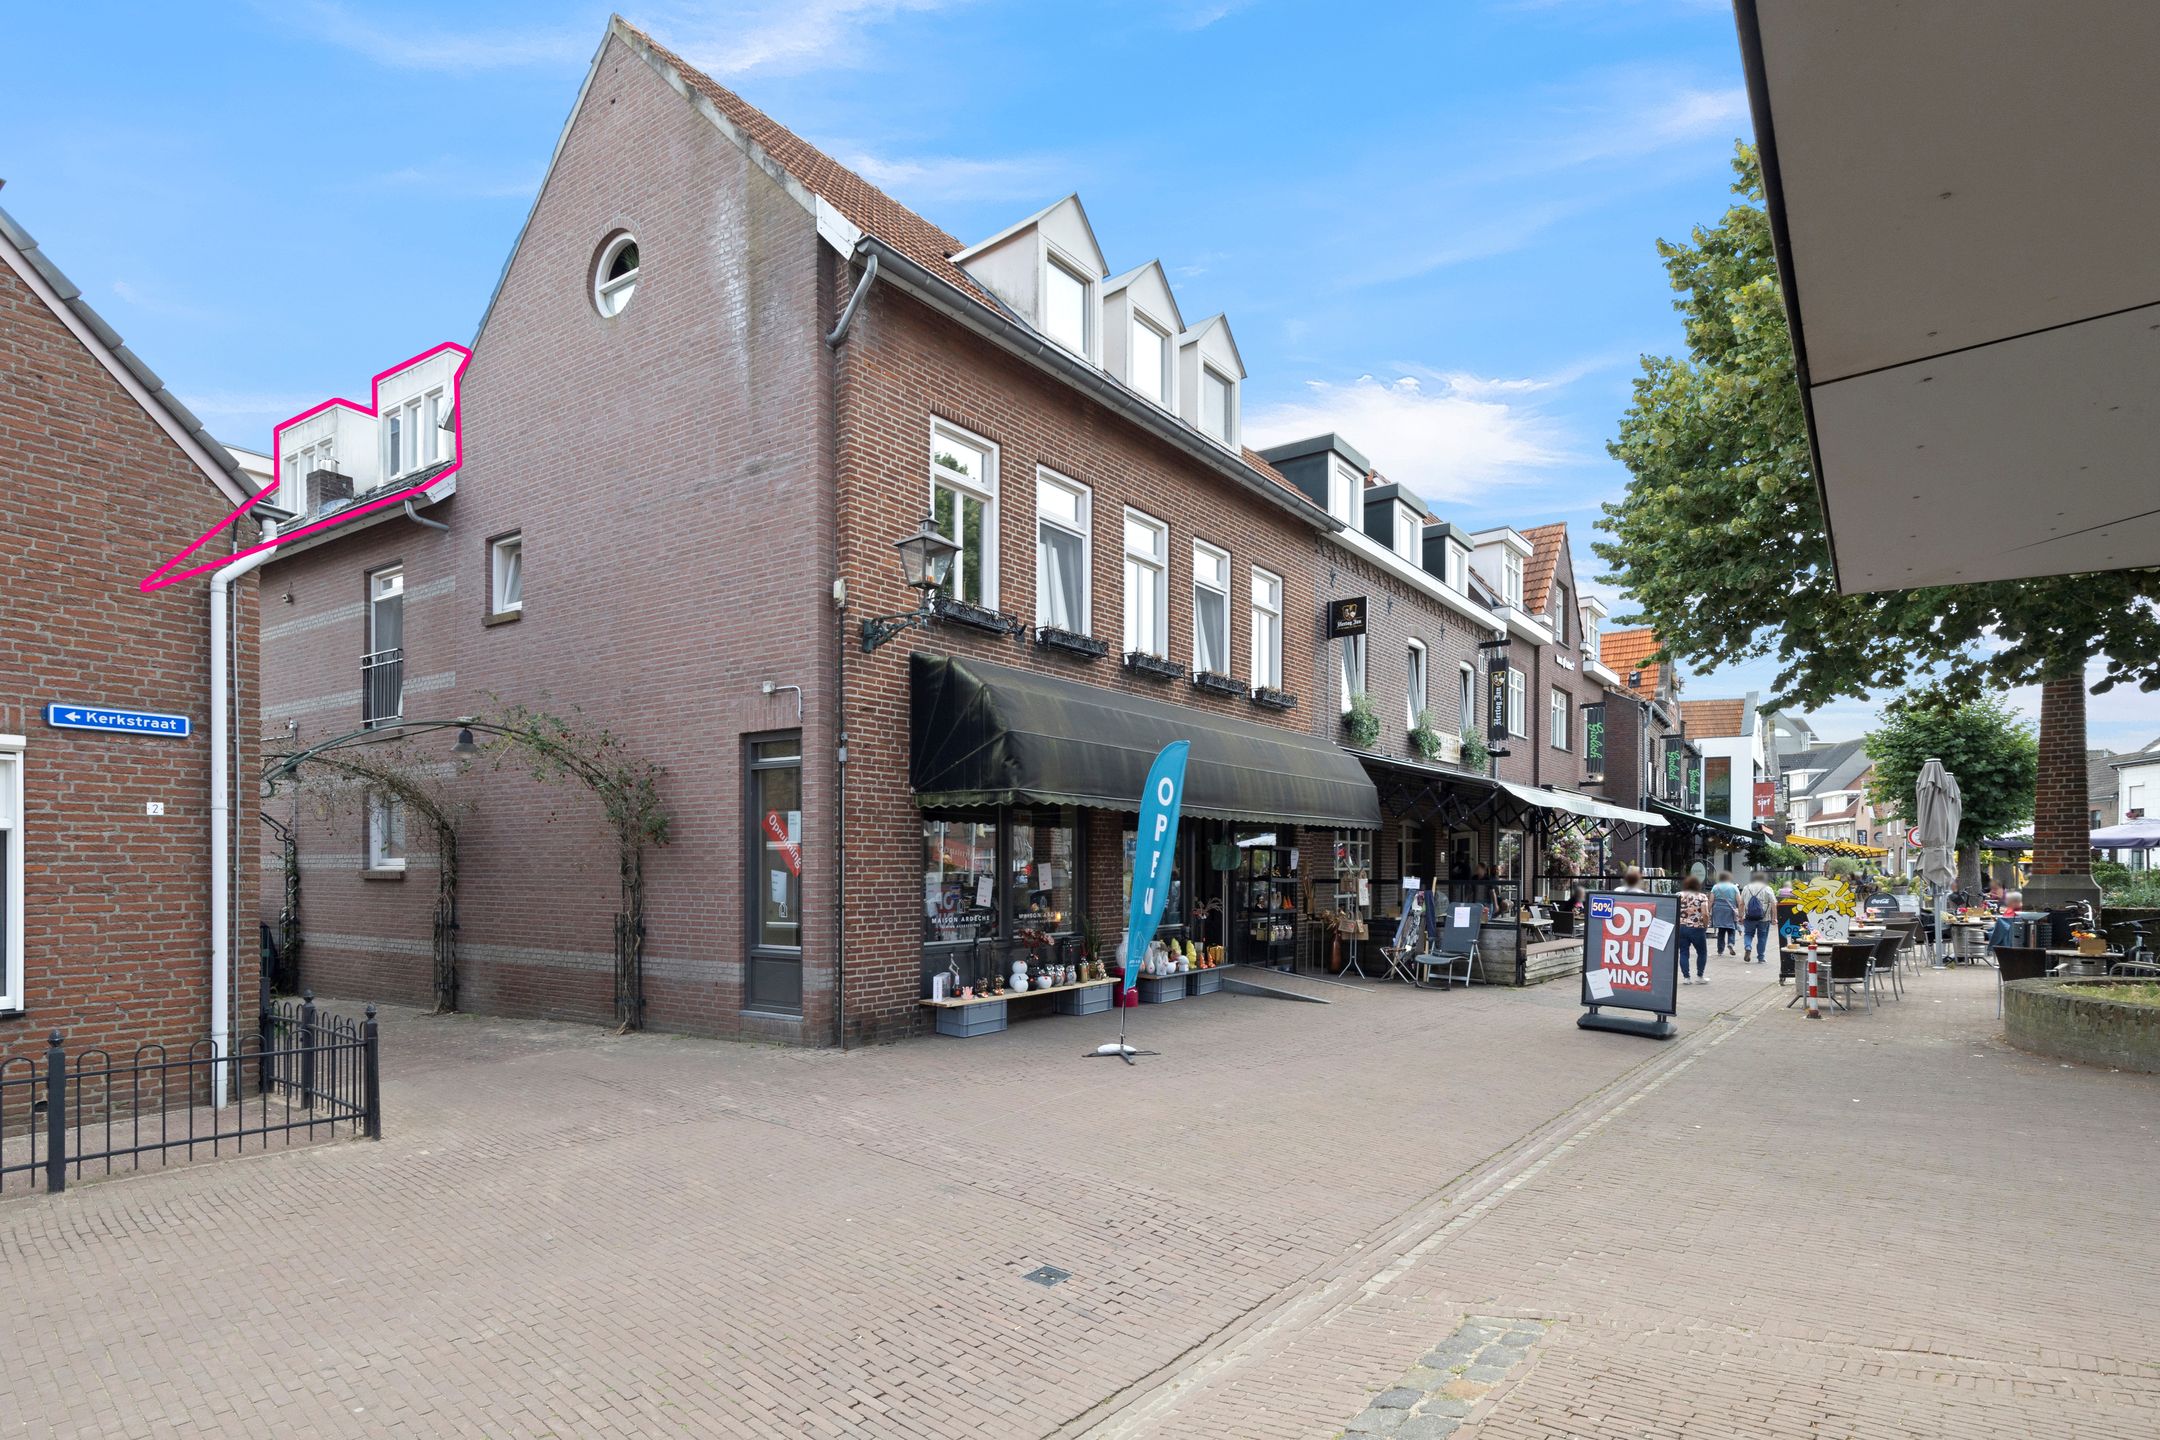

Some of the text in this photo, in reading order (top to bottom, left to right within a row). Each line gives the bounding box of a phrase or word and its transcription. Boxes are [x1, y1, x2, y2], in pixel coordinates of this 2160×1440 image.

[86, 712, 177, 730] Kerkstraat
[1493, 687, 1503, 726] Hertog Jan
[1588, 722, 1604, 759] Grolsch
[1667, 750, 1681, 781] Grolsch
[1688, 768, 1700, 795] Grolsch
[152, 804, 159, 814] 2
[769, 814, 802, 869] Opruiming
[1592, 902, 1612, 913] 50%
[1605, 906, 1652, 936] OP
[1604, 939, 1649, 967] RUI
